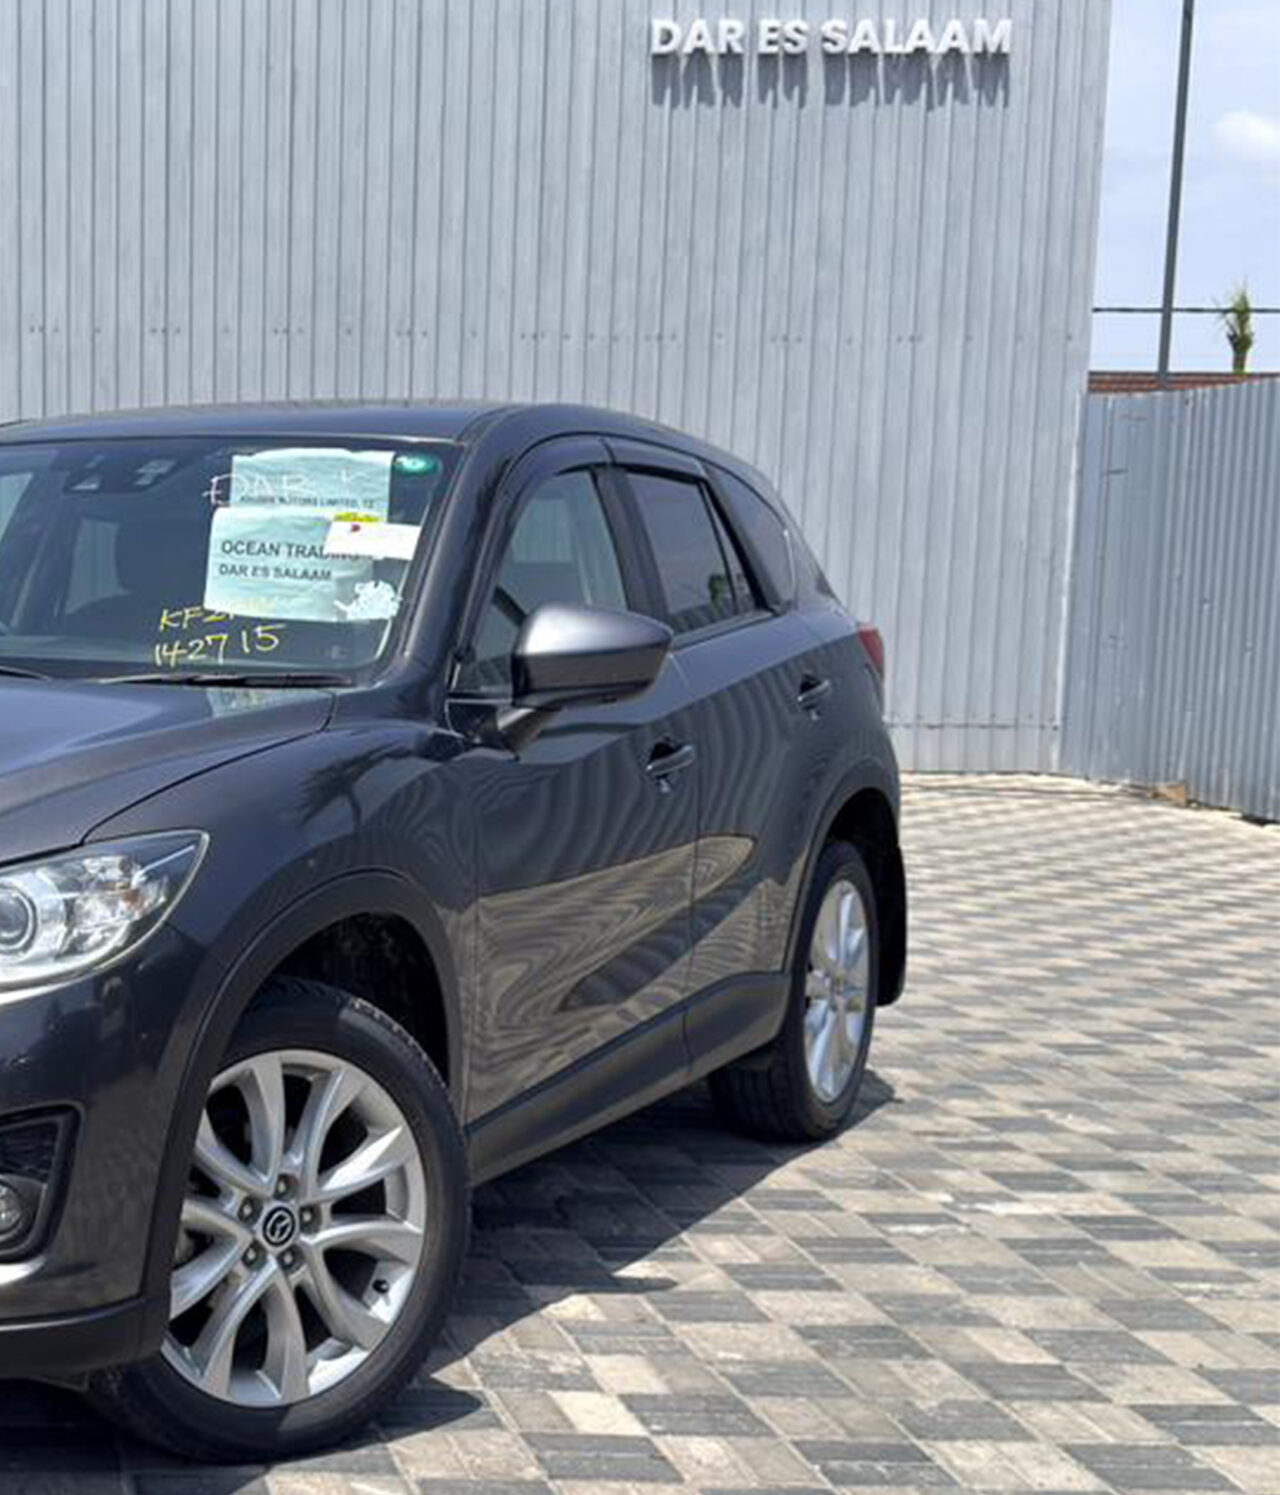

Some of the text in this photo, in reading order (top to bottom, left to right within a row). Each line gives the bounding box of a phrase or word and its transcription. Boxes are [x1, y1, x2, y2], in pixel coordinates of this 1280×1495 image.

[651, 18, 1013, 55] DAR ES SALAAM
[221, 540, 280, 557] OCEAN
[219, 563, 332, 581] DAR ES SALAAM
